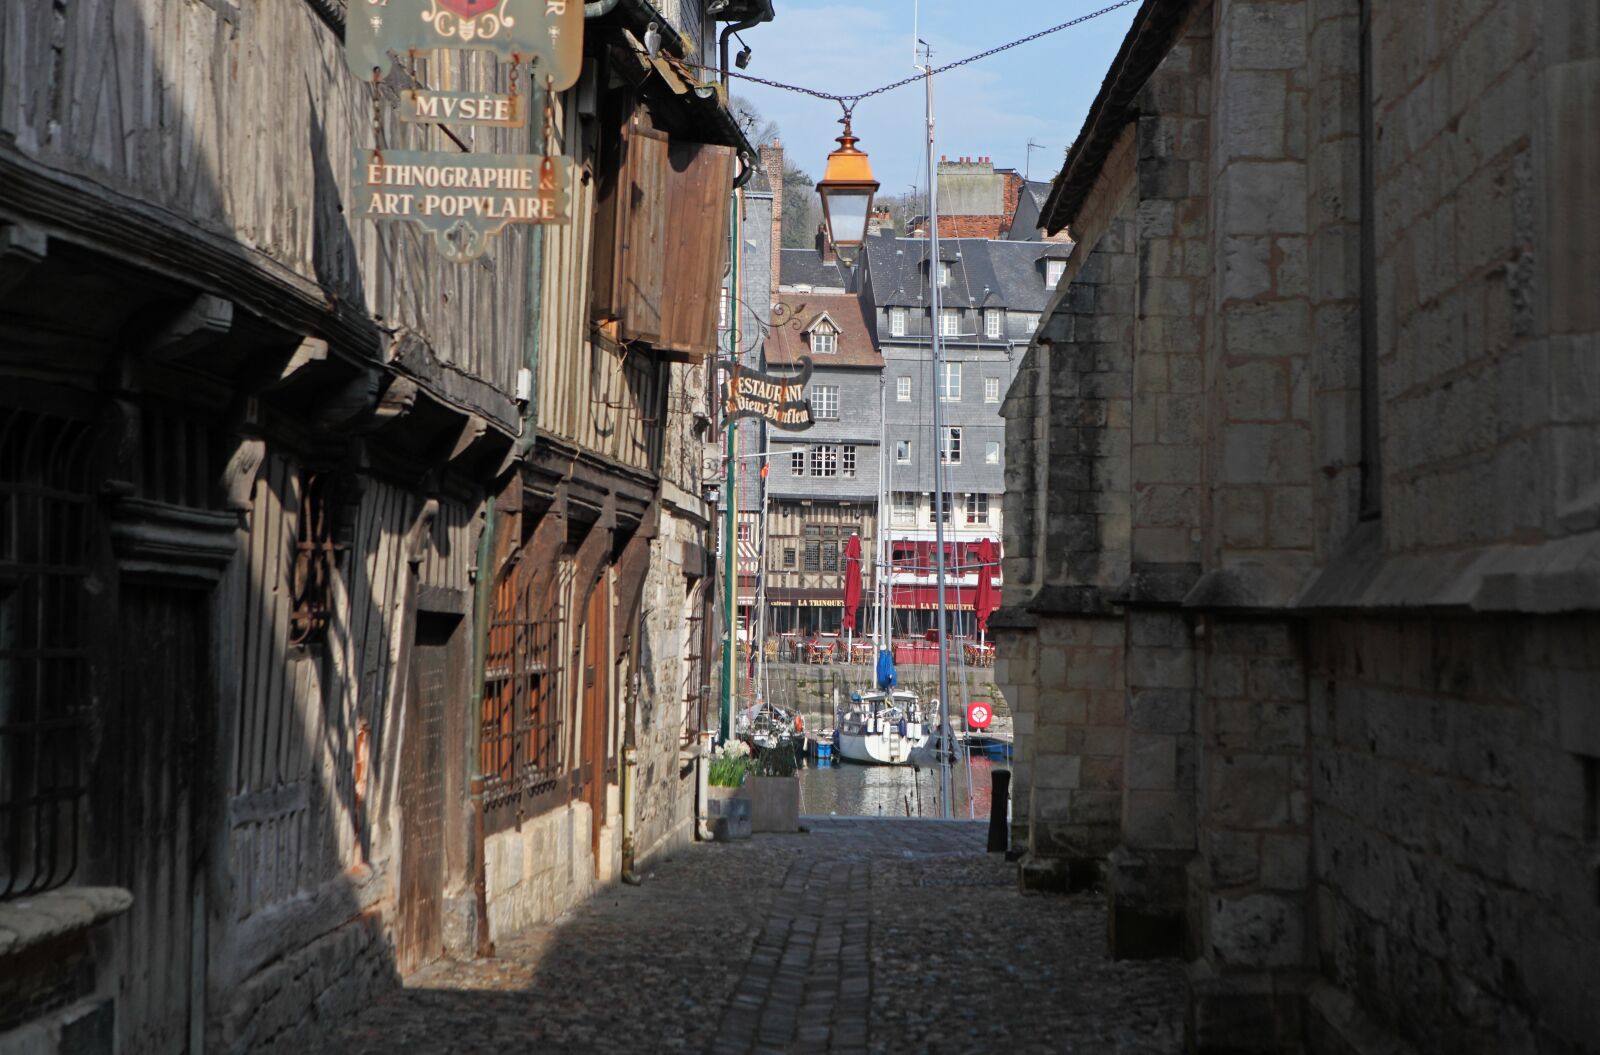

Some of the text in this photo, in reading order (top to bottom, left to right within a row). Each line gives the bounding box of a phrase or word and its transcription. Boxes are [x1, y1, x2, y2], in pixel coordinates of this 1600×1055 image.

[368, 164, 533, 189] ETHNOGRAPHIE
[367, 194, 415, 215] ART
[727, 377, 803, 402] RESTAURANT
